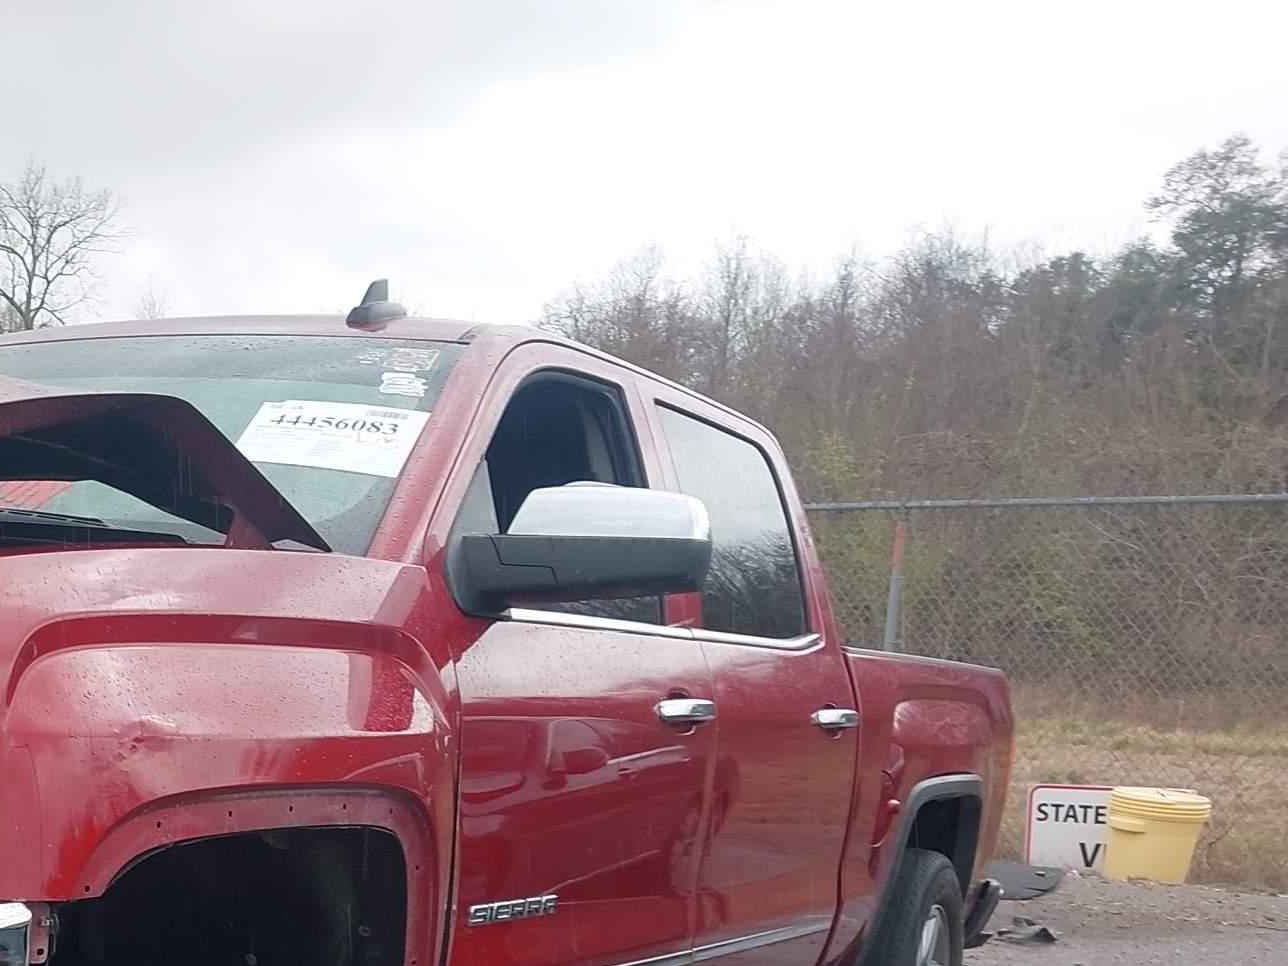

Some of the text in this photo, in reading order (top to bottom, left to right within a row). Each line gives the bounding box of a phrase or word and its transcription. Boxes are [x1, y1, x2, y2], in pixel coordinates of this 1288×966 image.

[270, 414, 399, 435] 44456083
[1036, 803, 1107, 824] STATE
[469, 895, 558, 926] SIERRA
